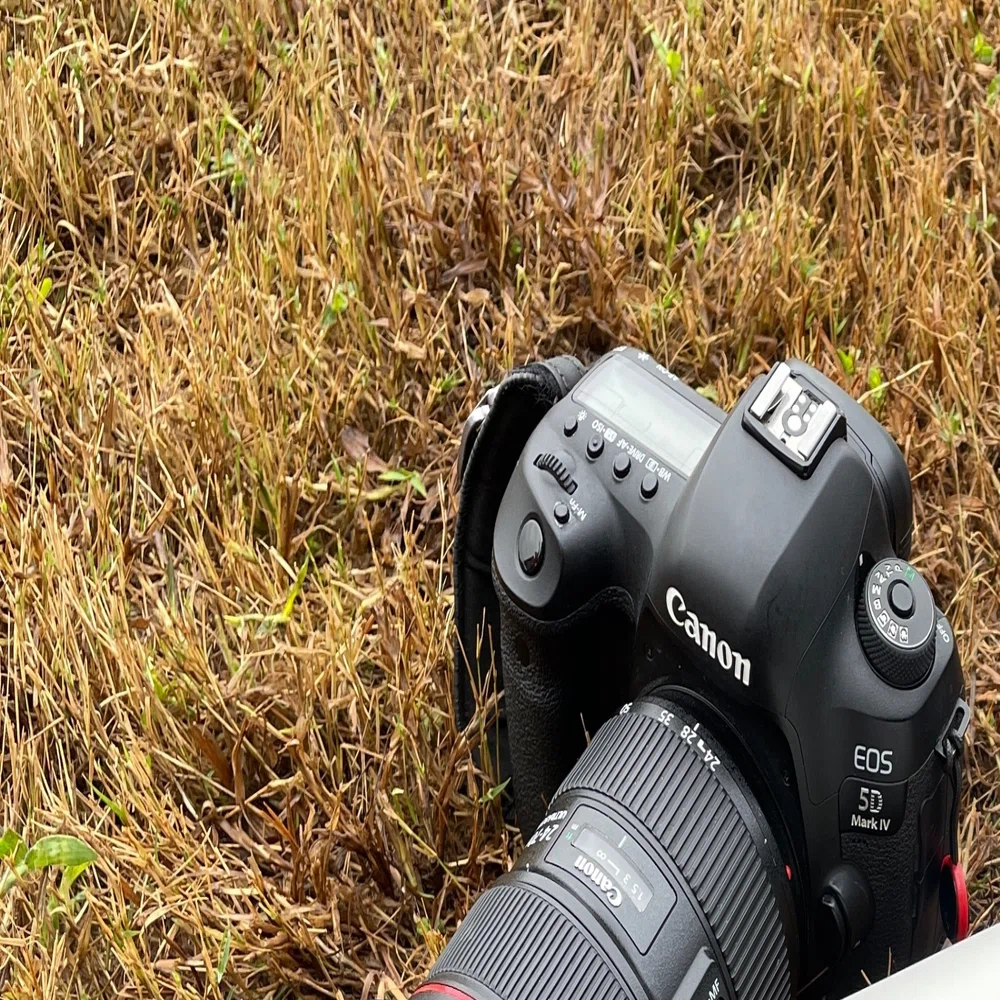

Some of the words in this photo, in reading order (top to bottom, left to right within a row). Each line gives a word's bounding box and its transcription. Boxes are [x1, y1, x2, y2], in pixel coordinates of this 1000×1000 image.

[666, 586, 751, 687] Canon
[657, 710, 675, 726] 35
[680, 725, 698, 745] 28
[704, 750, 721, 772] 24
[854, 745, 893, 775] EOS
[858, 786, 883, 814] 5D
[850, 814, 878, 830] Mark
[879, 819, 891, 831] IV
[574, 855, 623, 907] Canon
